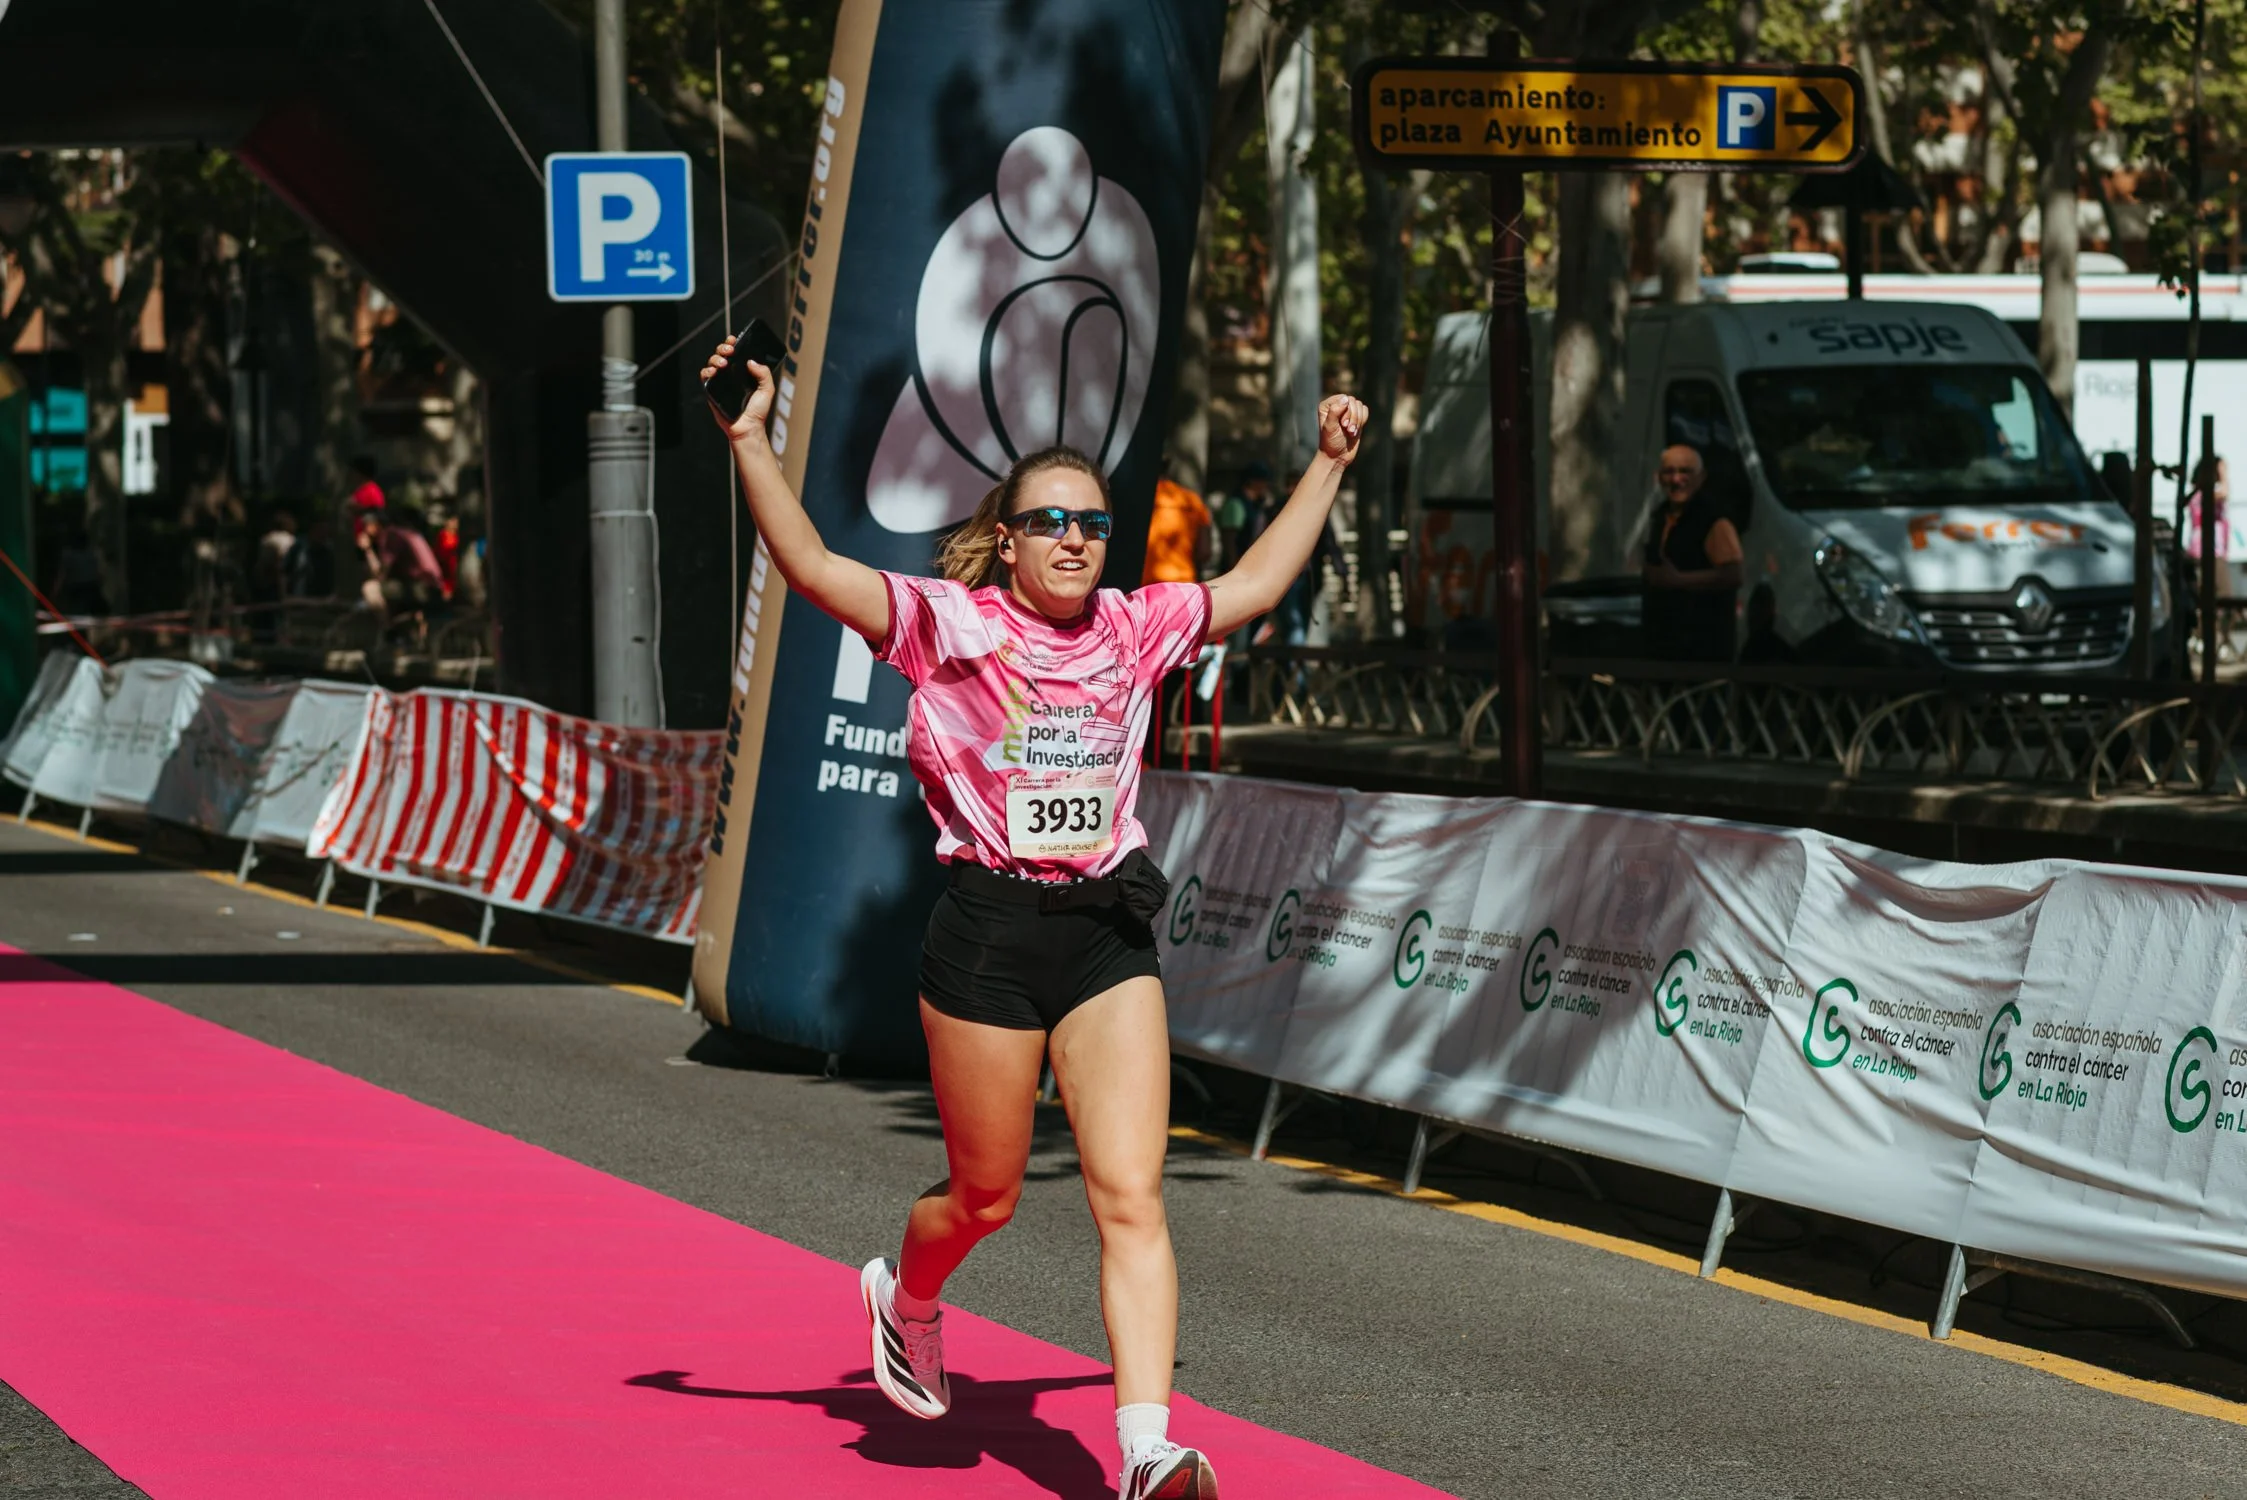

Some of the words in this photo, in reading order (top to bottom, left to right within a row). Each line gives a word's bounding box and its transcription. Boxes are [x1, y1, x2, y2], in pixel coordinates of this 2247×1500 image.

[1380, 84, 1606, 112] aparcamiento:
[1379, 118, 1462, 148] plaza
[1484, 119, 1703, 149] Ayuntamiento
[1727, 92, 1766, 145] P
[577, 171, 662, 282] P
[824, 713, 908, 759] Fund
[1028, 725, 1060, 744] por
[1061, 725, 1077, 744] la
[817, 759, 900, 798] para
[1027, 796, 1102, 834] 3933
[1321, 925, 1334, 942] el
[1334, 928, 1373, 949] cáncer
[1481, 930, 1522, 951] española
[1307, 944, 1337, 970] Rioja
[1465, 950, 1500, 972] cáncer
[1557, 967, 1589, 987] contra
[1589, 969, 1600, 988] el
[1600, 971, 1632, 994] cáncer
[1551, 994, 1565, 1009] en
[1565, 992, 1577, 1012] La
[1576, 994, 1602, 1021] Rioja
[1697, 991, 1731, 1012] contra
[1731, 994, 1743, 1014] el
[1868, 998, 1932, 1023] asociación
[1932, 1007, 1984, 1032] española
[1689, 1020, 1704, 1037] en
[1704, 1018, 1718, 1038] La
[1717, 1020, 1744, 1048] Rioja
[1860, 1025, 1902, 1046] contra
[1901, 1029, 1916, 1049] el
[1915, 1032, 1956, 1056] cáncer
[2032, 1019, 2100, 1046] asociación
[2101, 1029, 2163, 1054] española
[1852, 1053, 1871, 1071] en
[1870, 1052, 1888, 1075] La
[1888, 1055, 1918, 1083] Rioja
[2025, 1049, 2068, 1073] contra
[2068, 1052, 2082, 1075] el
[2083, 1054, 2130, 1081] cáncer
[2018, 1080, 2034, 1099] en
[2035, 1078, 2054, 1102] La
[2055, 1081, 2088, 1112] Rioja
[2215, 1110, 2235, 1130] en
